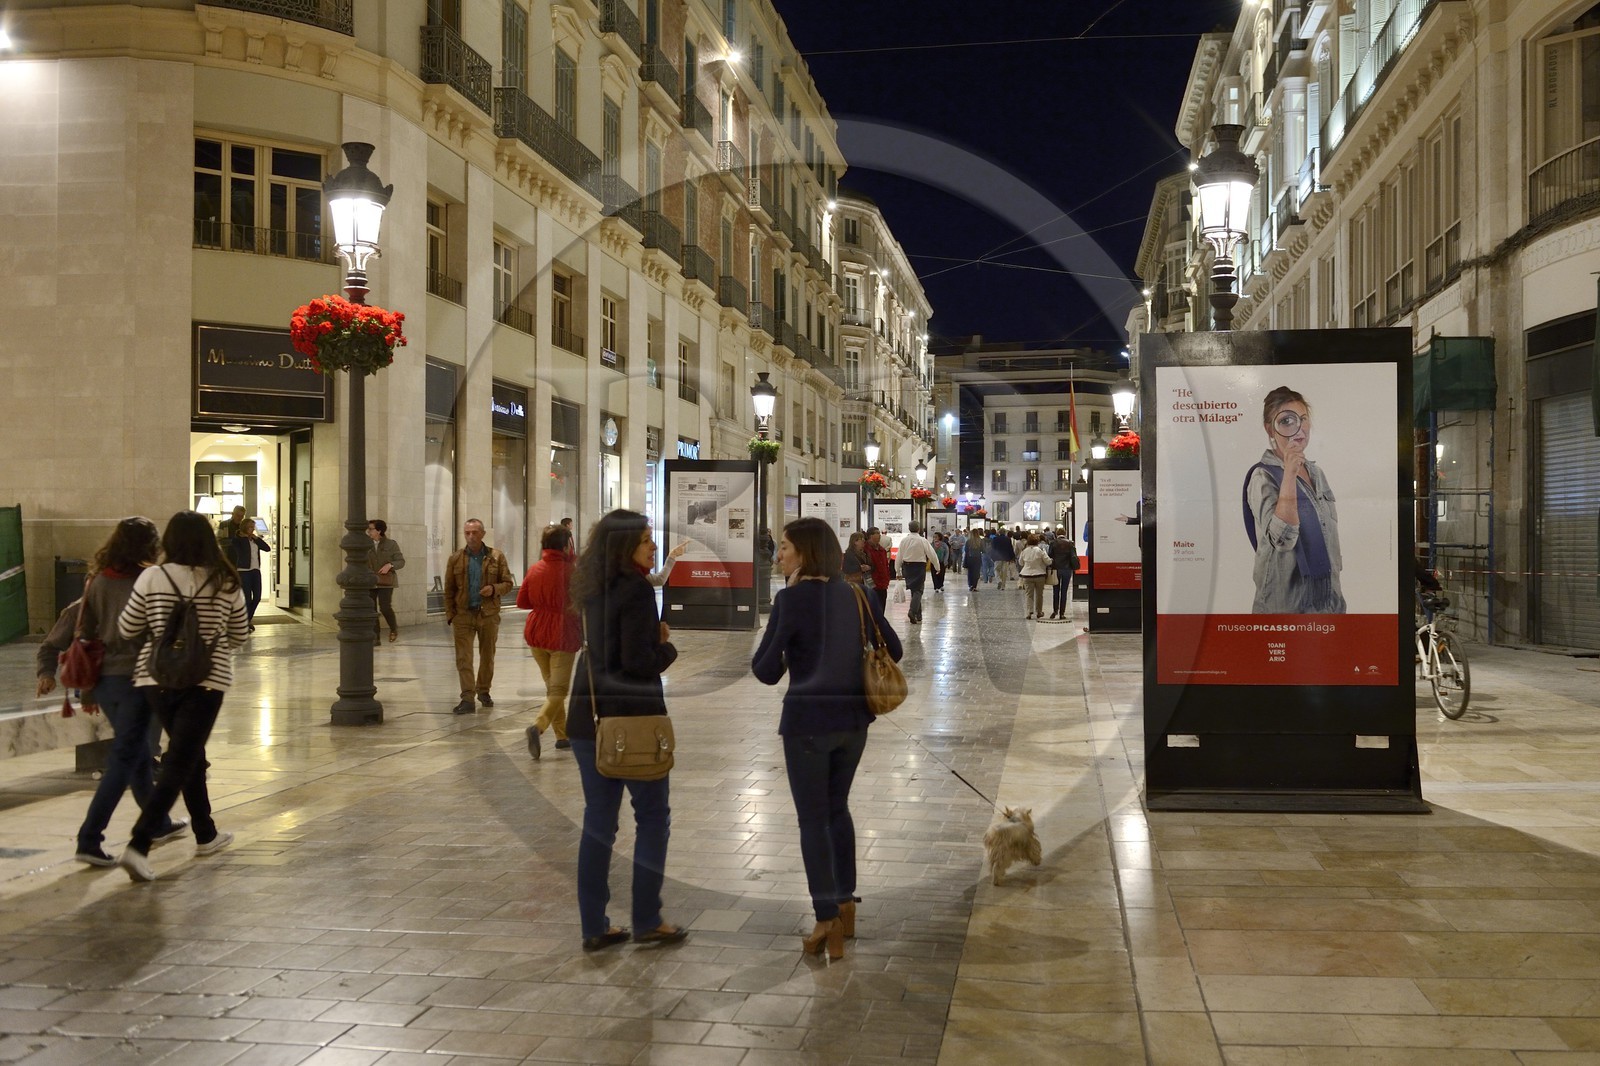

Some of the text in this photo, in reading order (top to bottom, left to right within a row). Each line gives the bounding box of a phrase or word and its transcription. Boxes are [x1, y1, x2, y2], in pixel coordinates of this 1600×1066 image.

[278, 353, 314, 370] Dutt
[1172, 400, 1238, 410] descubierto
[1172, 414, 1195, 423] otra
[1173, 540, 1195, 548] Maite
